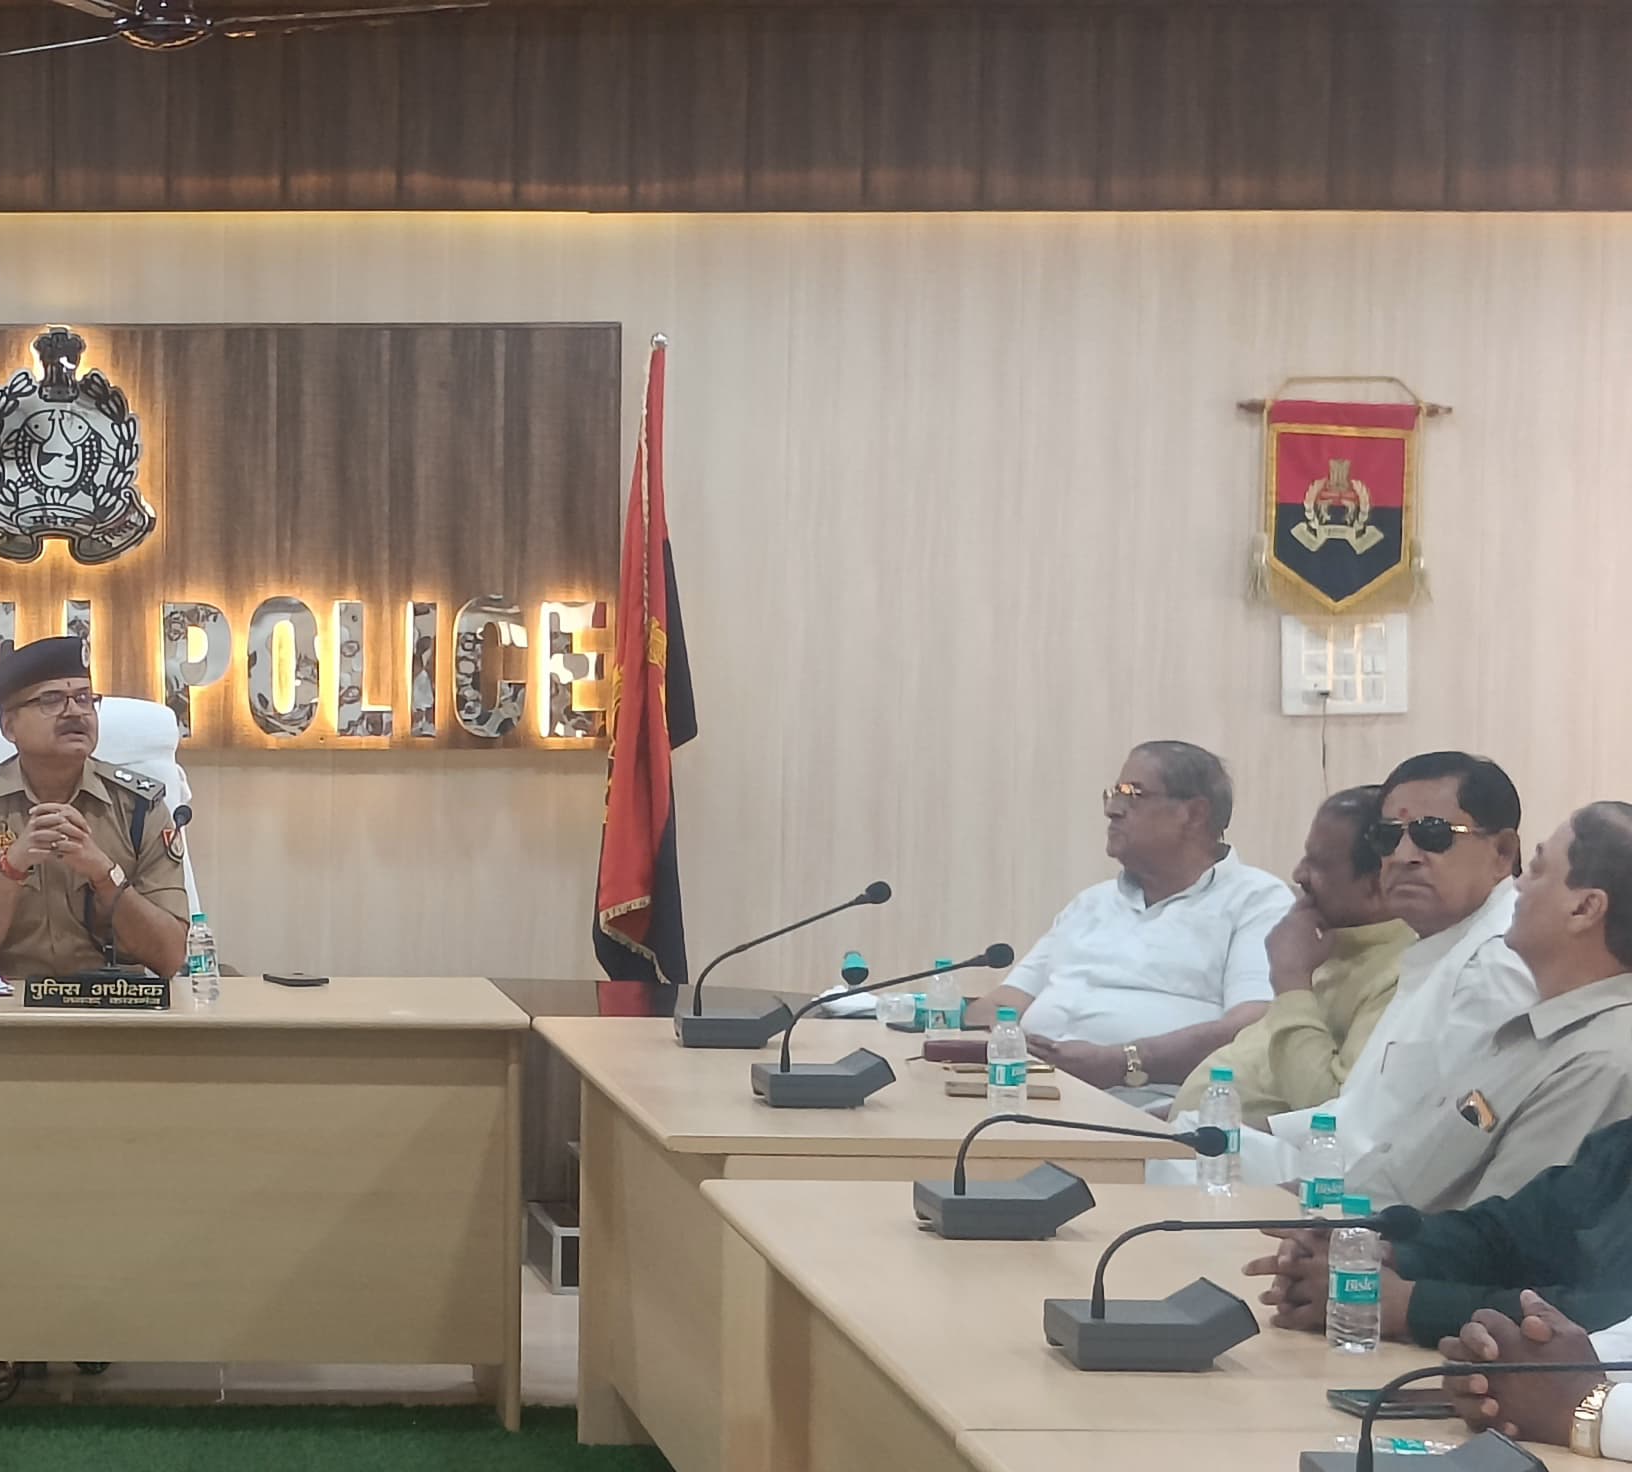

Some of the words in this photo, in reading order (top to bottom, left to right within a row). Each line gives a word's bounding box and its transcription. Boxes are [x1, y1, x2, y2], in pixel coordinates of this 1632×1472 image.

[161, 596, 607, 739] POLICE
[30, 978, 81, 1000] पुलिस
[90, 978, 165, 996] अधीक्षक
